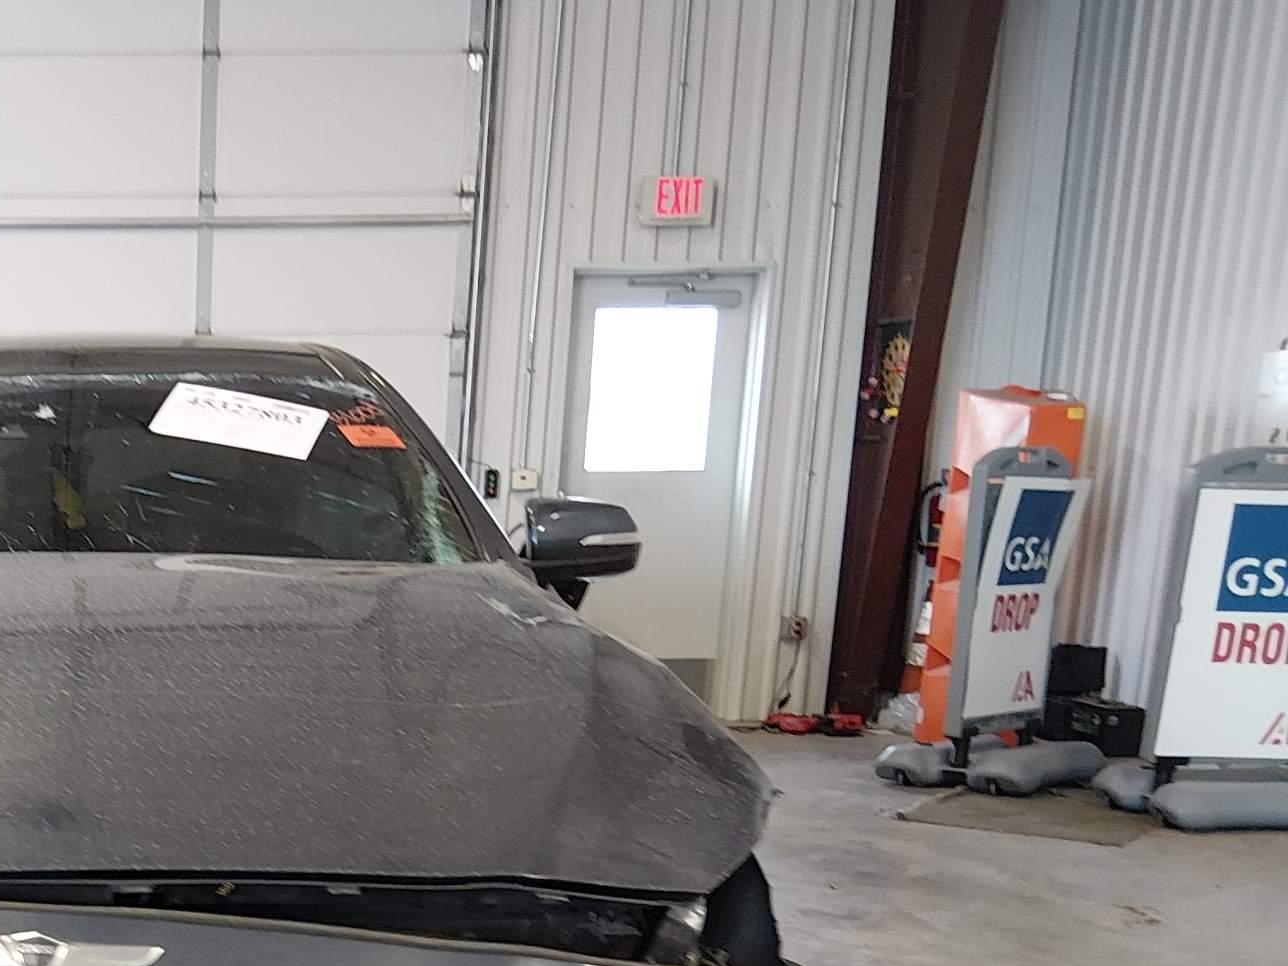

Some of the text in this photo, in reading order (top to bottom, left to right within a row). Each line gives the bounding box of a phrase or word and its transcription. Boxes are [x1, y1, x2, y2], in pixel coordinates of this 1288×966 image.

[657, 178, 704, 214] EXIT
[1005, 536, 1050, 571] GSA
[1225, 556, 1288, 598] GS
[991, 592, 1040, 632] DROP
[1211, 622, 1288, 665] DRO
